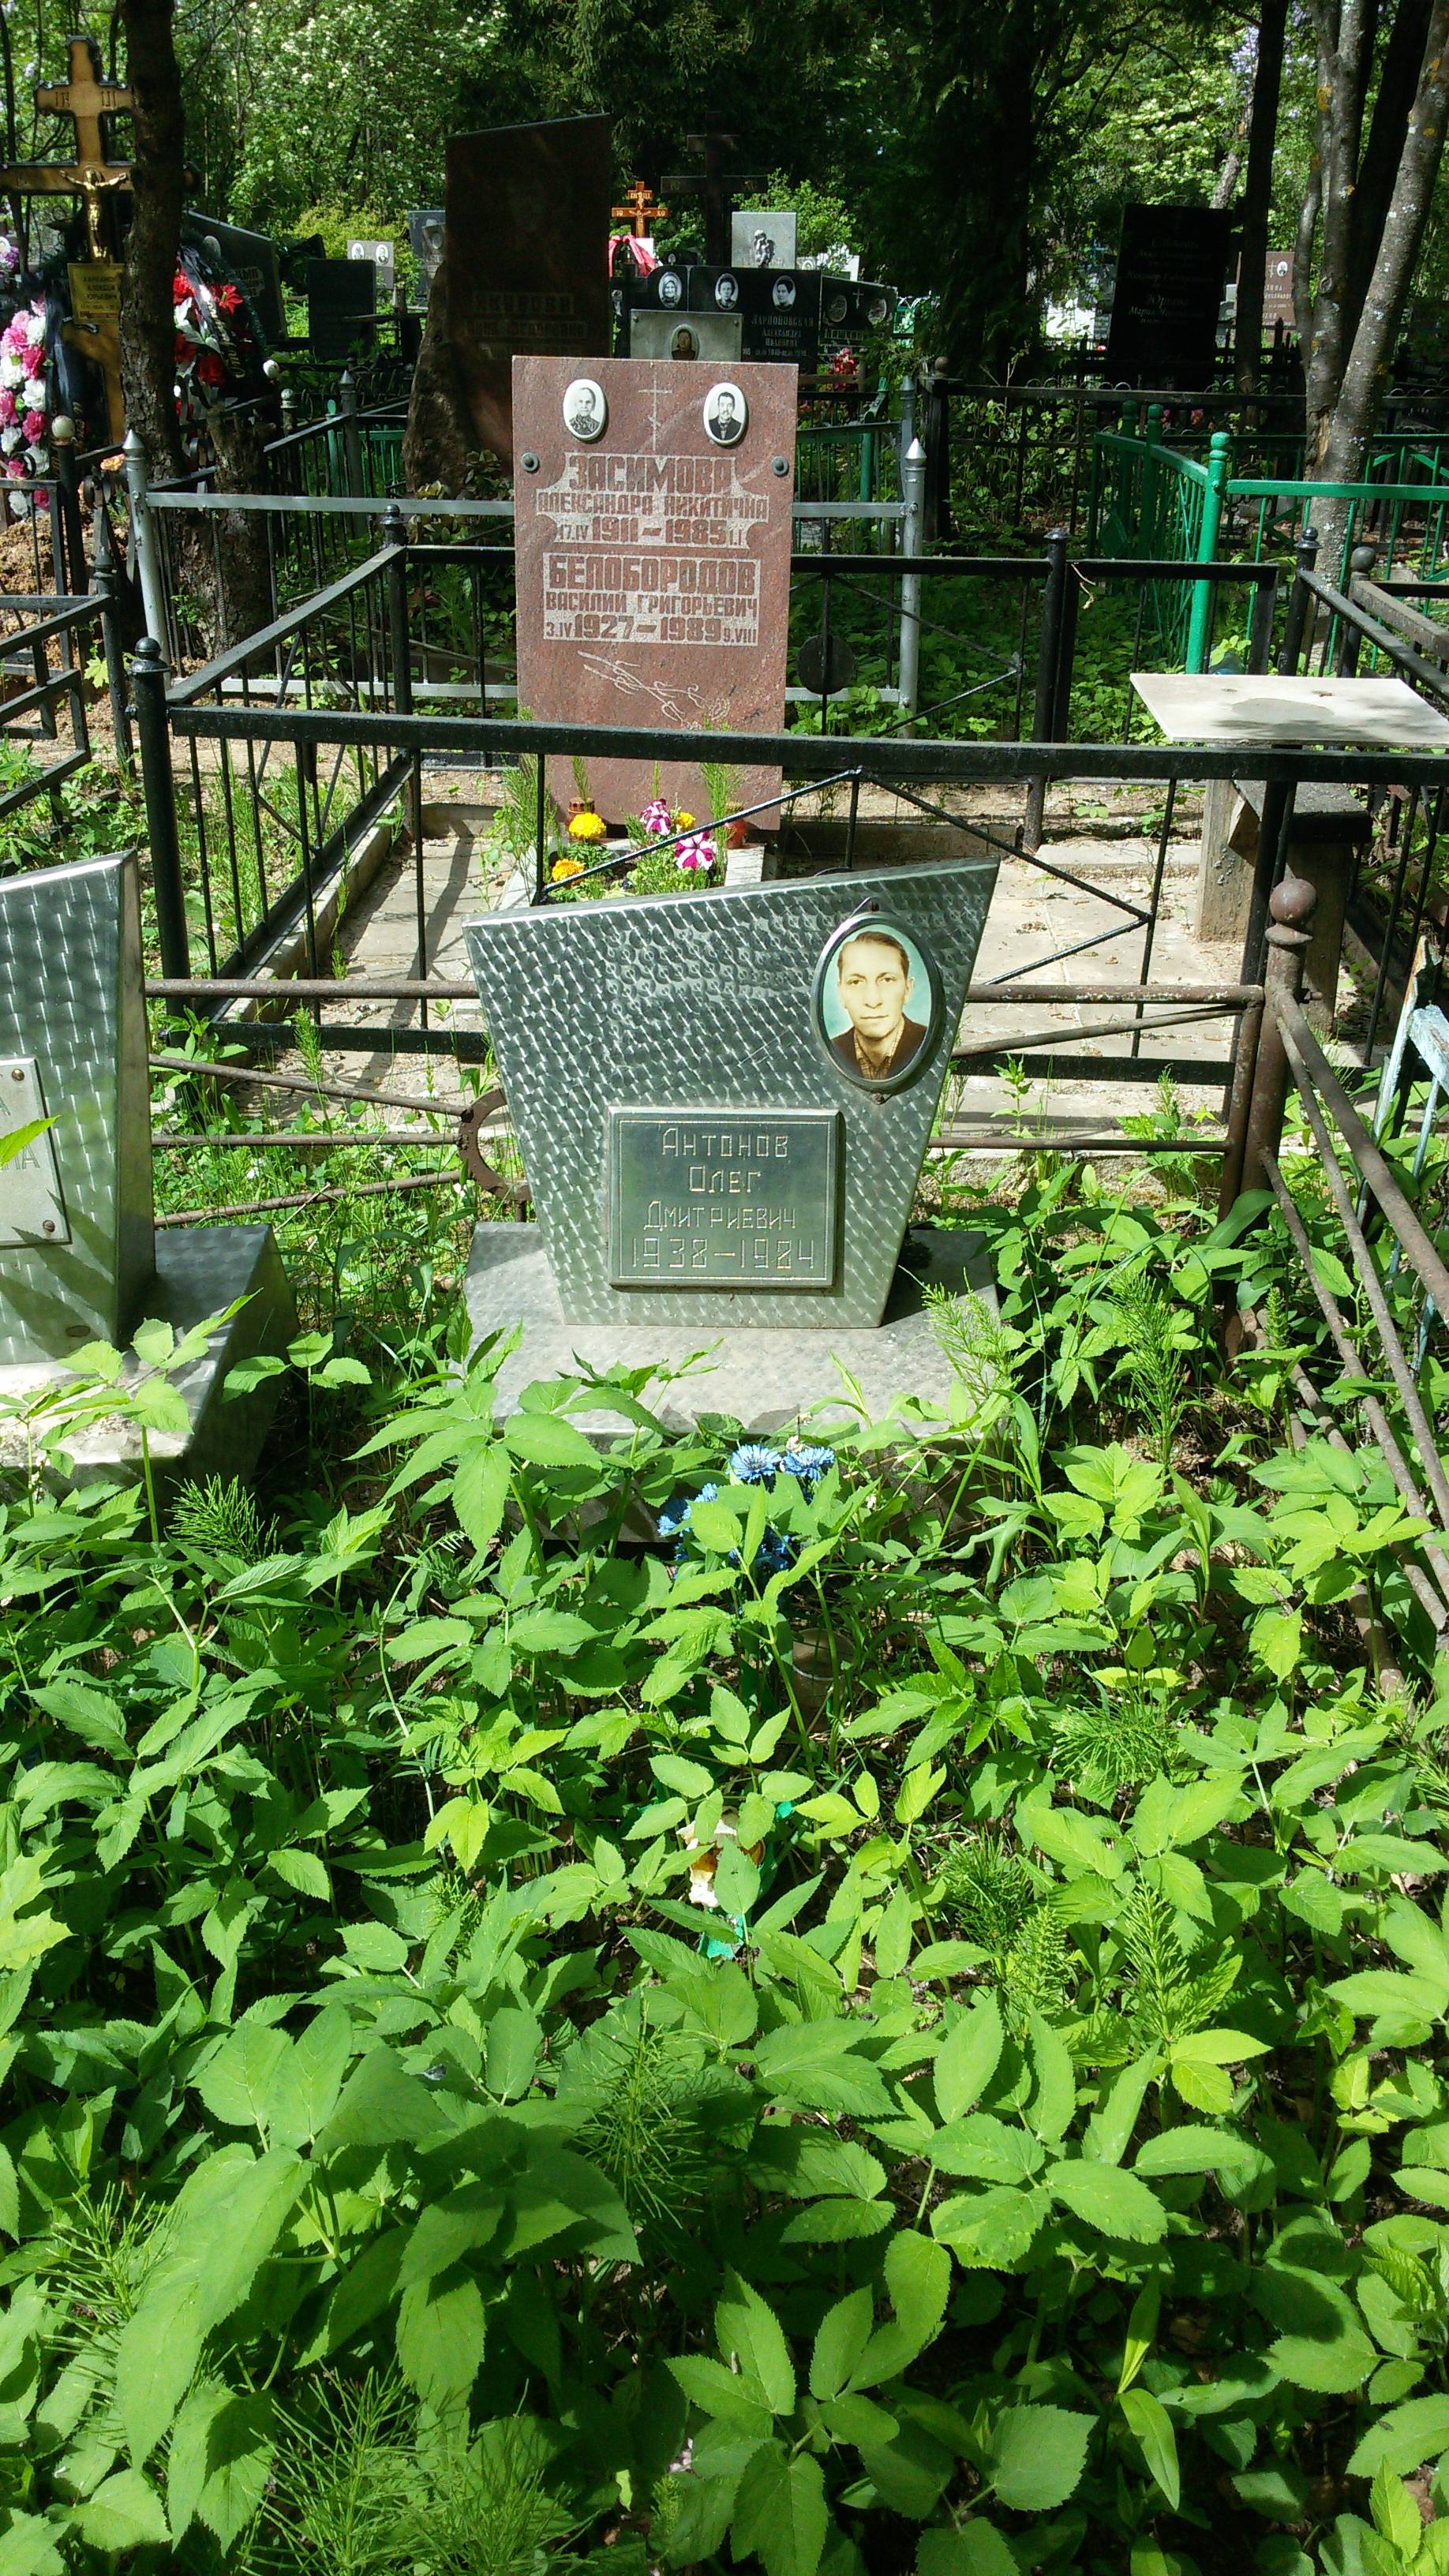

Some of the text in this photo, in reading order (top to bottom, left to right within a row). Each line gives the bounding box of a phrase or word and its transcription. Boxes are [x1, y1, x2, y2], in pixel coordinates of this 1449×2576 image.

[568, 455, 734, 495] ЗАСИМОВА
[538, 492, 768, 519] АЛЕКСАНДРА НИКИТИЧНА
[549, 554, 757, 595] БЕЛОБОРОДОВ
[637, 594, 758, 618] ГРИГОРЬЕВИЧ
